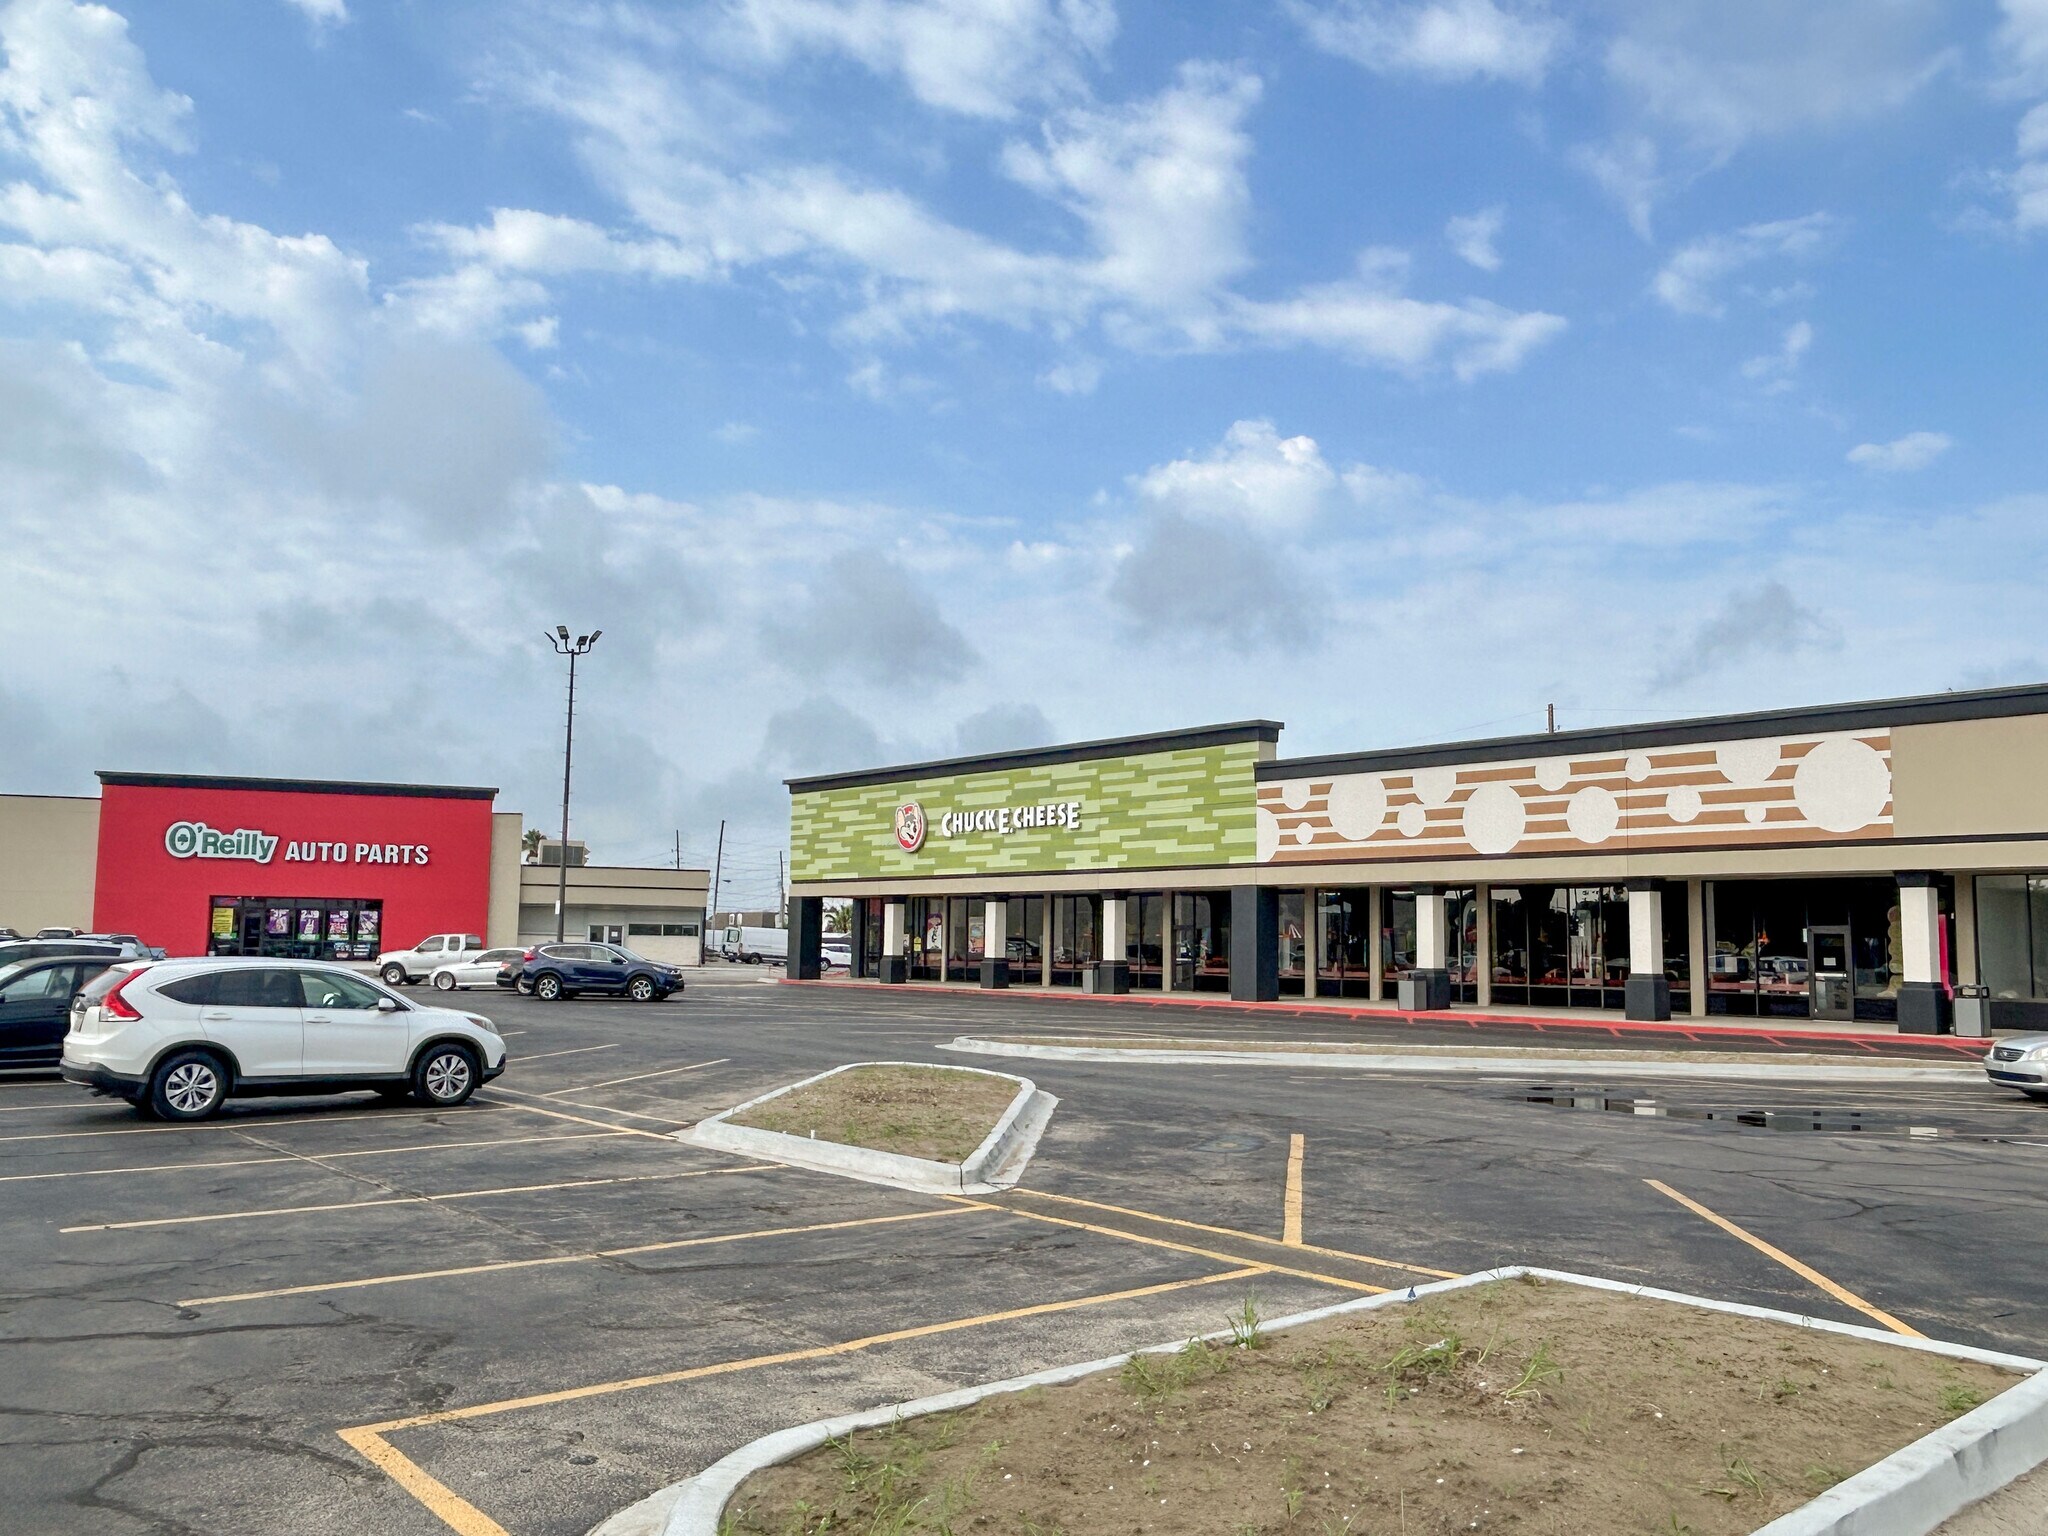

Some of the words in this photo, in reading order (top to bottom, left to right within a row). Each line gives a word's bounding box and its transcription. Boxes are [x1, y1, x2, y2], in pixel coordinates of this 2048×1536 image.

[942, 809, 996, 837] CHUCK
[1013, 802, 1080, 829] CHEESE
[167, 823, 275, 861] O'Reilly
[285, 842, 347, 862] AUTO
[355, 844, 429, 865] PARTS
